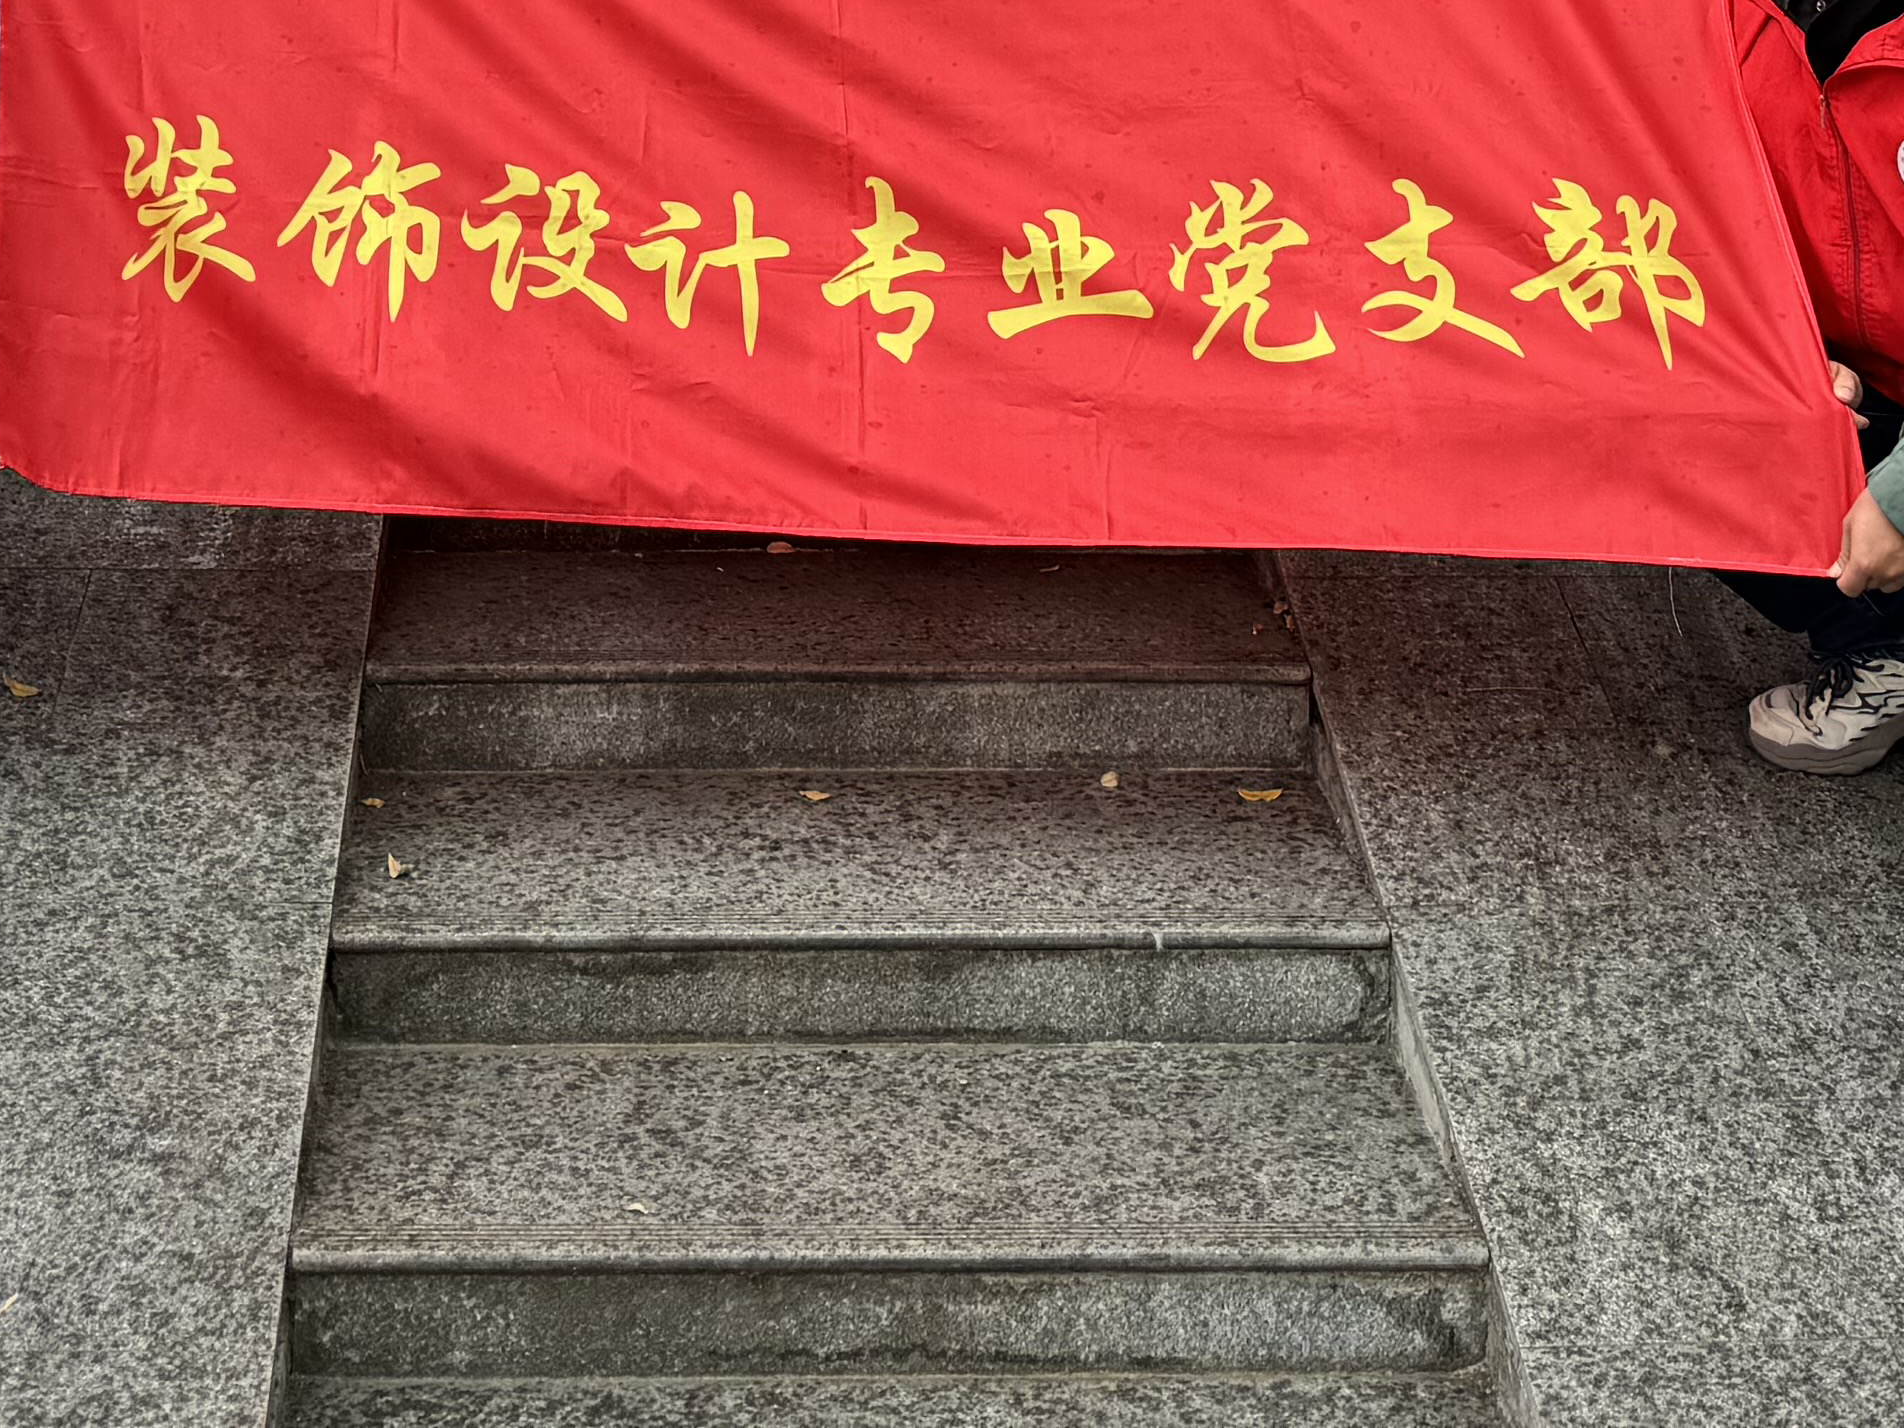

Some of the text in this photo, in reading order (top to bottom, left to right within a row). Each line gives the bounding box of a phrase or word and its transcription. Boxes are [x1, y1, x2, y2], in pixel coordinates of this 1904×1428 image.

[120, 114, 1707, 368] 装饰设计专业党支部
